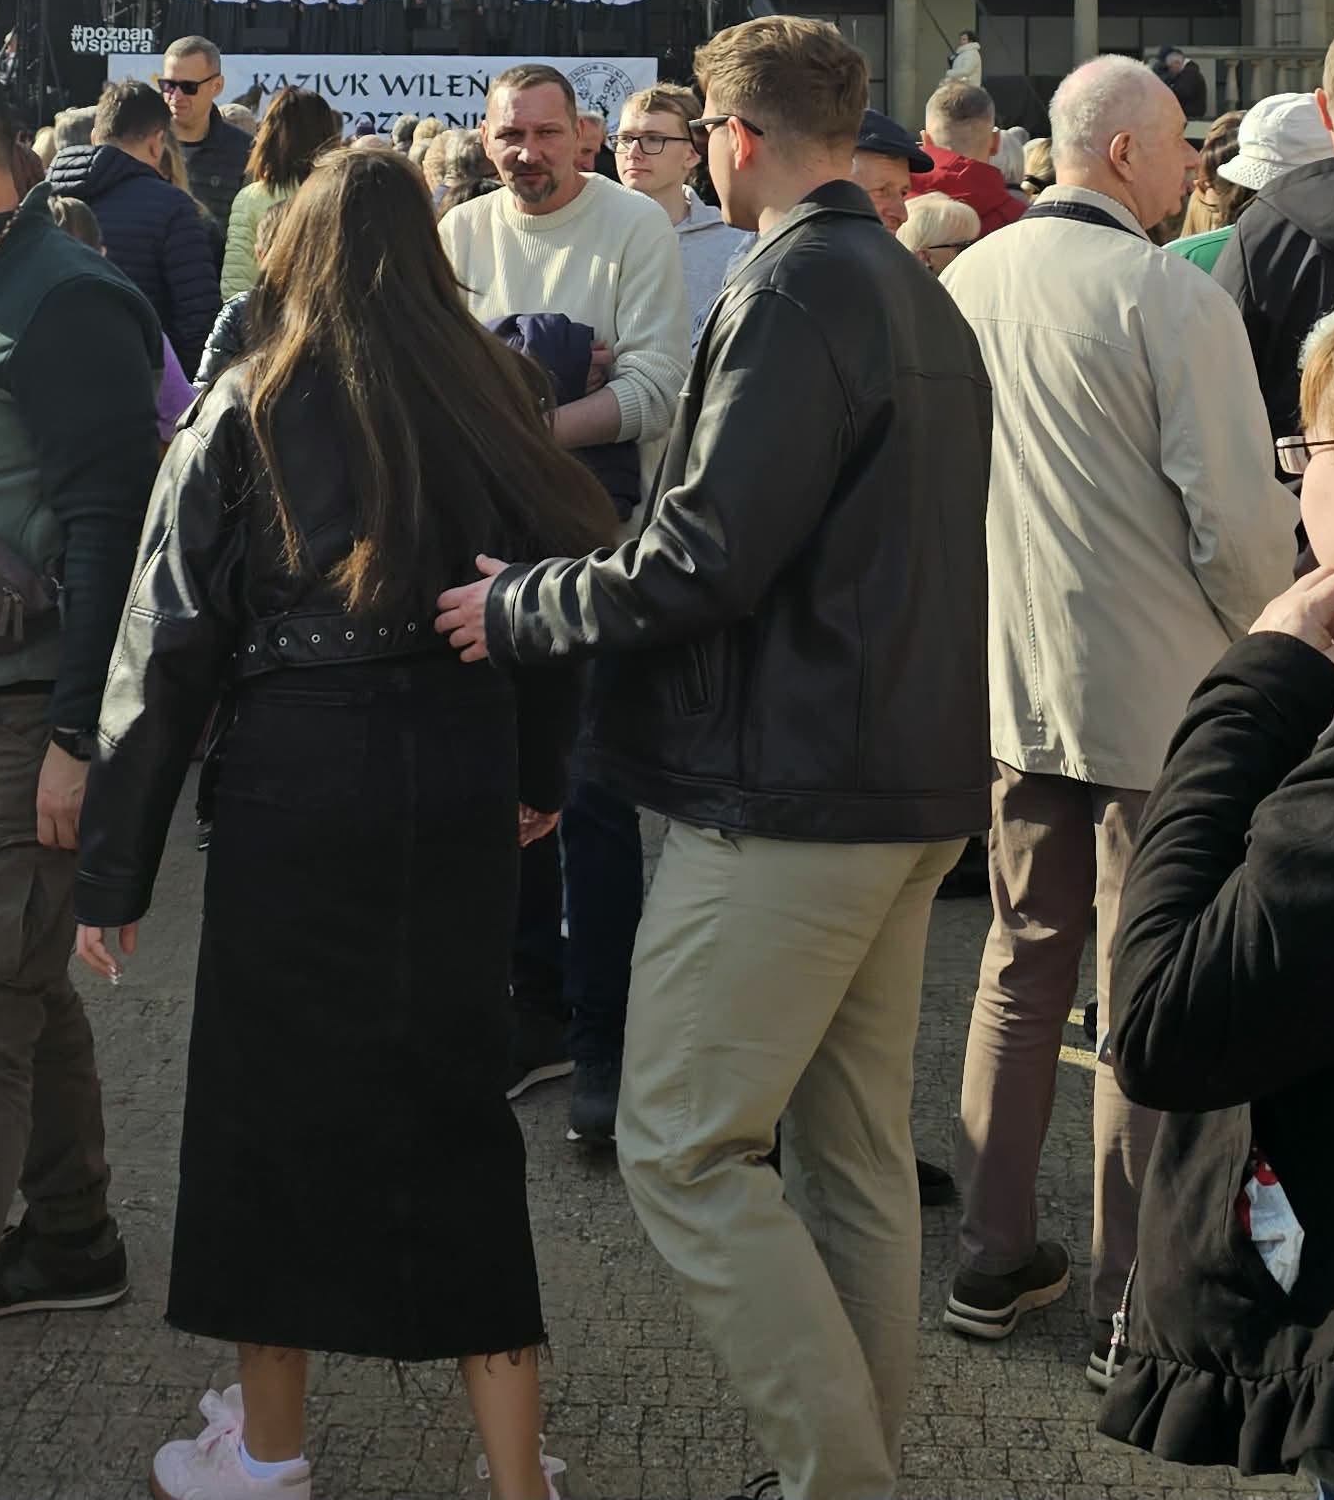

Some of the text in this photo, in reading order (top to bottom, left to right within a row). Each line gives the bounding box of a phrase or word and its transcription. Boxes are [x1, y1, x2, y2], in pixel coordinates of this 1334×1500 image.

[70, 24, 154, 44] #poznan
[70, 39, 152, 56] wspiera
[378, 68, 489, 97] WILEŃ
